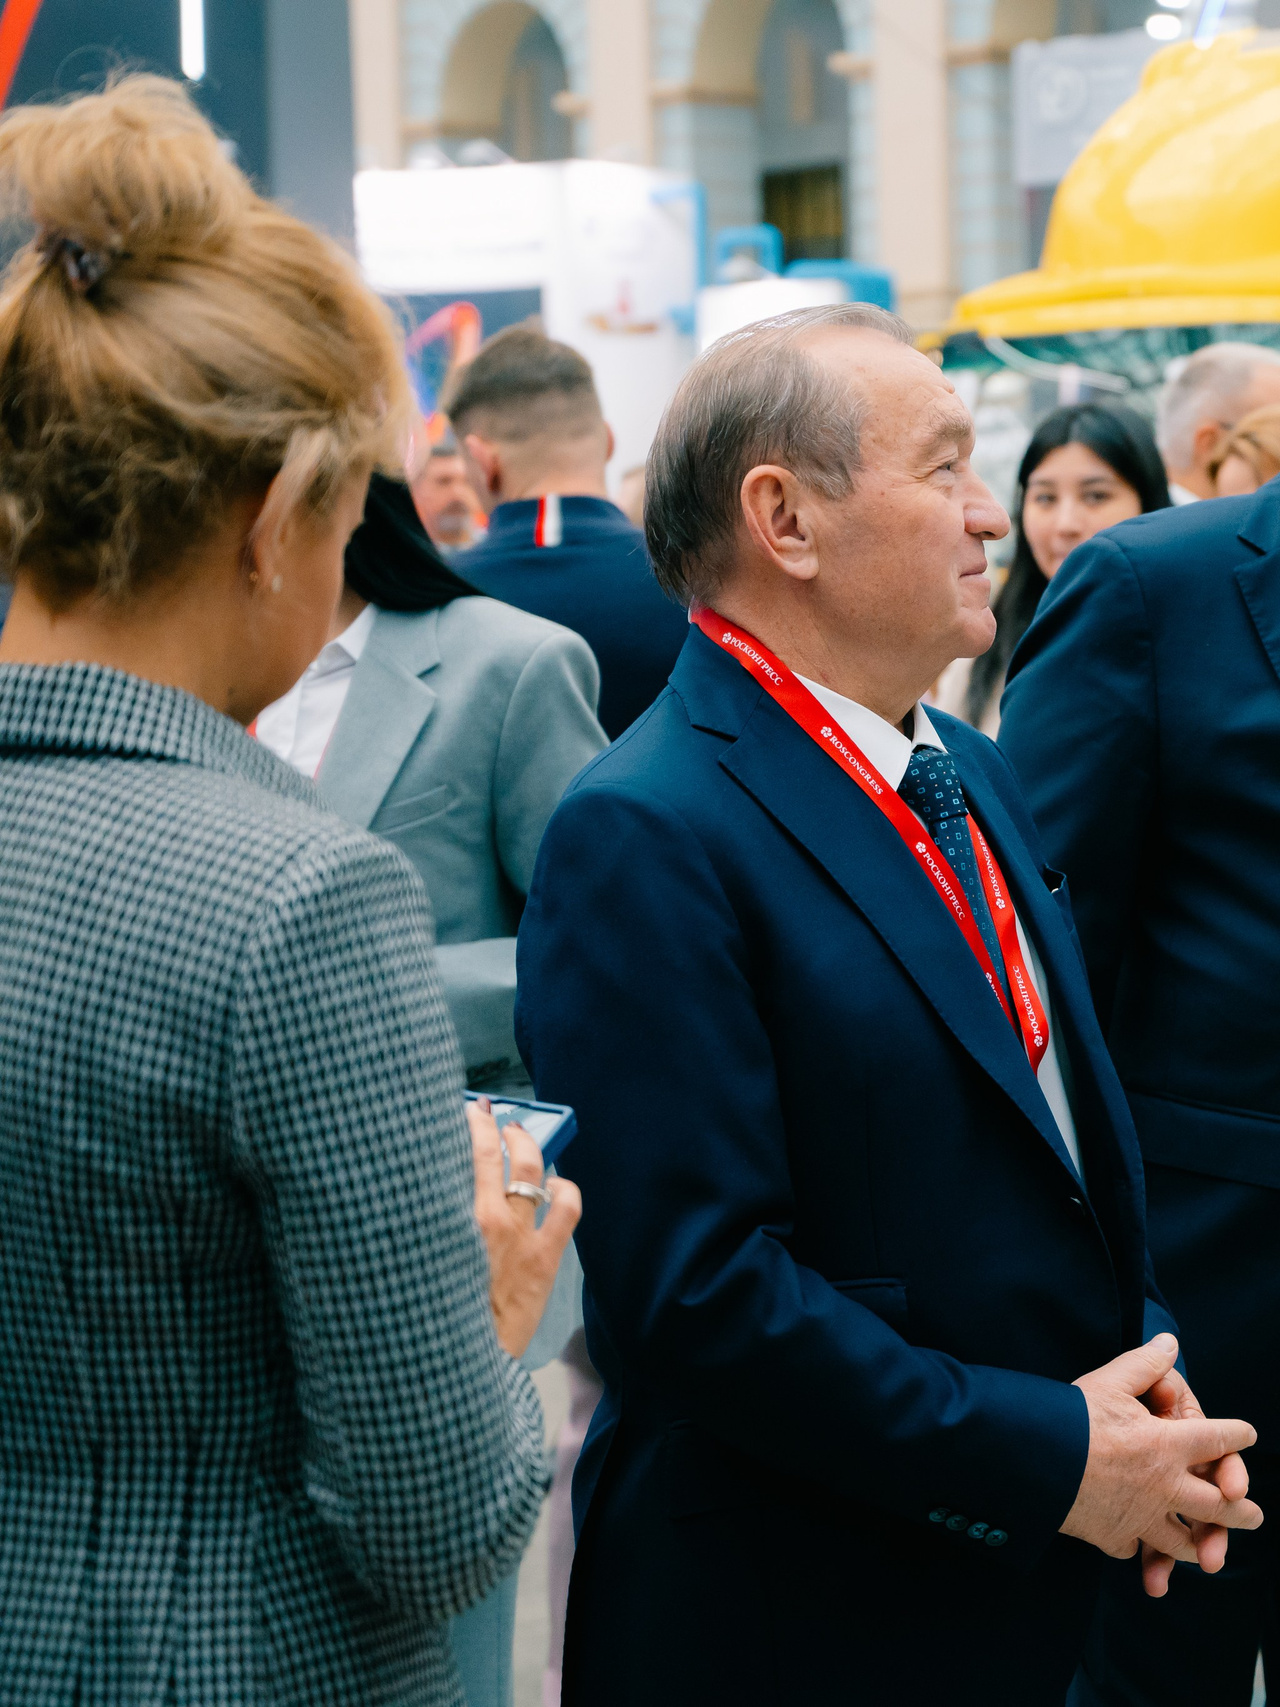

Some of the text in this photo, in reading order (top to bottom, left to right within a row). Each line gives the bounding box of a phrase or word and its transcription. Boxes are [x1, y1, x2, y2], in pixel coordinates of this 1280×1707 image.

[730, 636, 784, 686] РОСКОНГРЕСС
[829, 735, 884, 795] ROSCONGRESS
[923, 852, 966, 920] РОСКОНГРЕСС
[976, 831, 1002, 898] ROSCONGRESS
[1012, 965, 1041, 1035] РОСКОНГРЕСС
